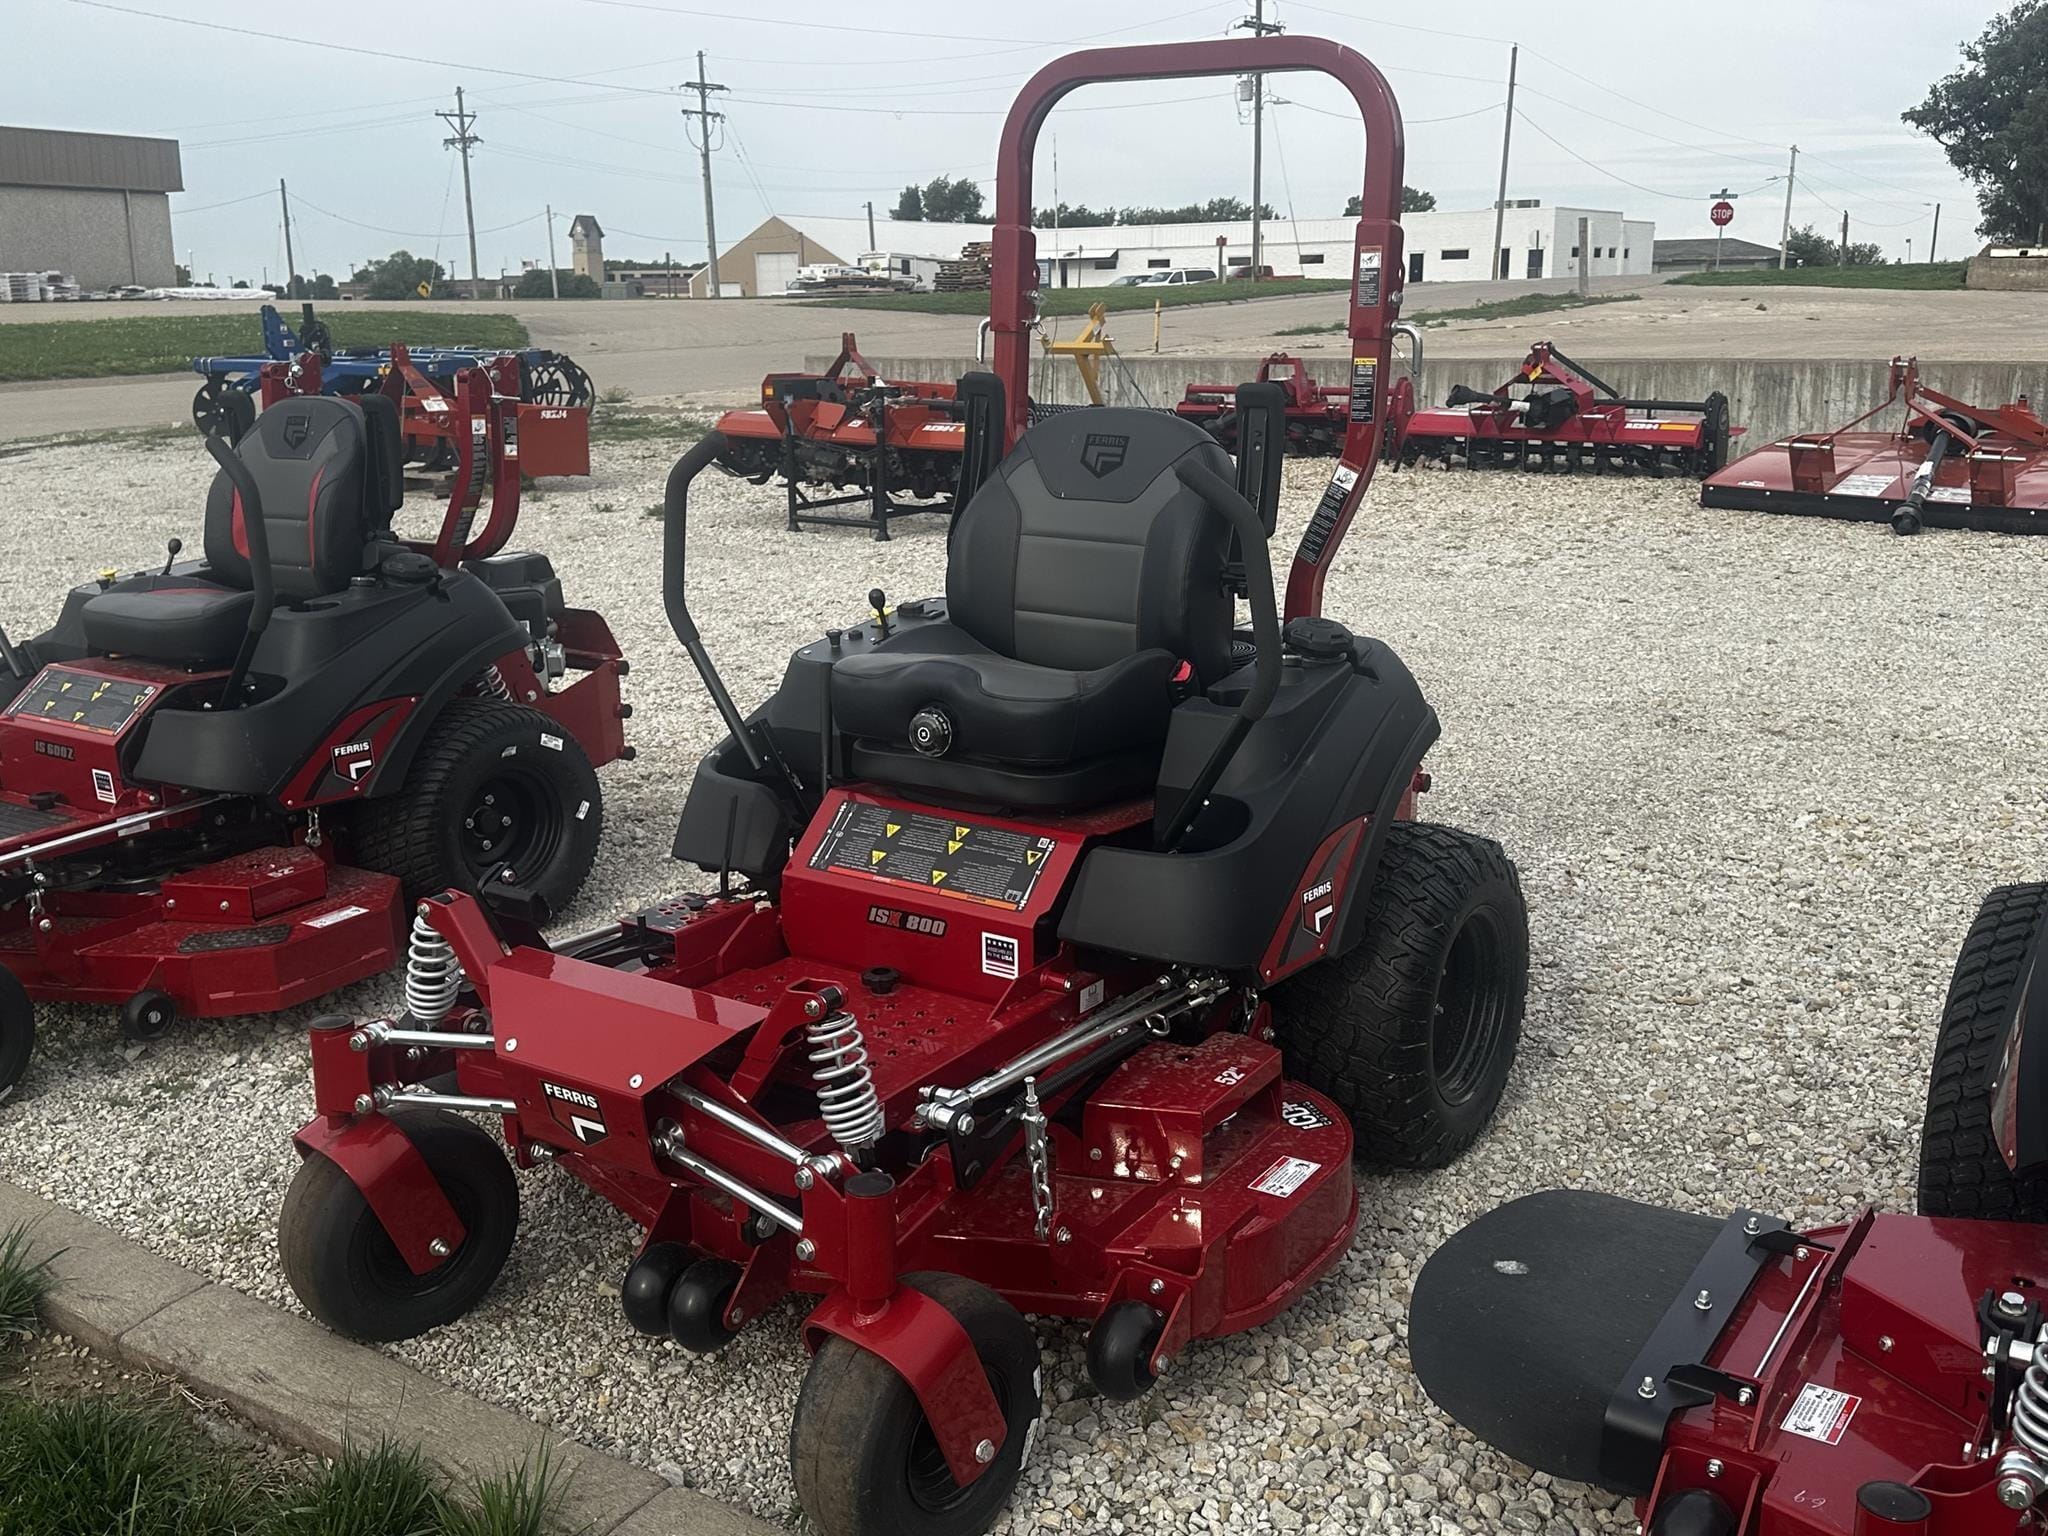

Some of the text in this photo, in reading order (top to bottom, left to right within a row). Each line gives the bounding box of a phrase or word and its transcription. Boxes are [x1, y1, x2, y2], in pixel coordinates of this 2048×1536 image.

[1711, 209, 1732, 219] STOP
[1089, 435, 1125, 447] FERRIS
[35, 741, 74, 760] IS 600Z
[334, 742, 370, 757] FERRIS
[1303, 881, 1332, 904] FERRIS
[869, 907, 946, 936] ISX 800
[1001, 954, 1013, 962] USA
[544, 1083, 598, 1109] FERRIS
